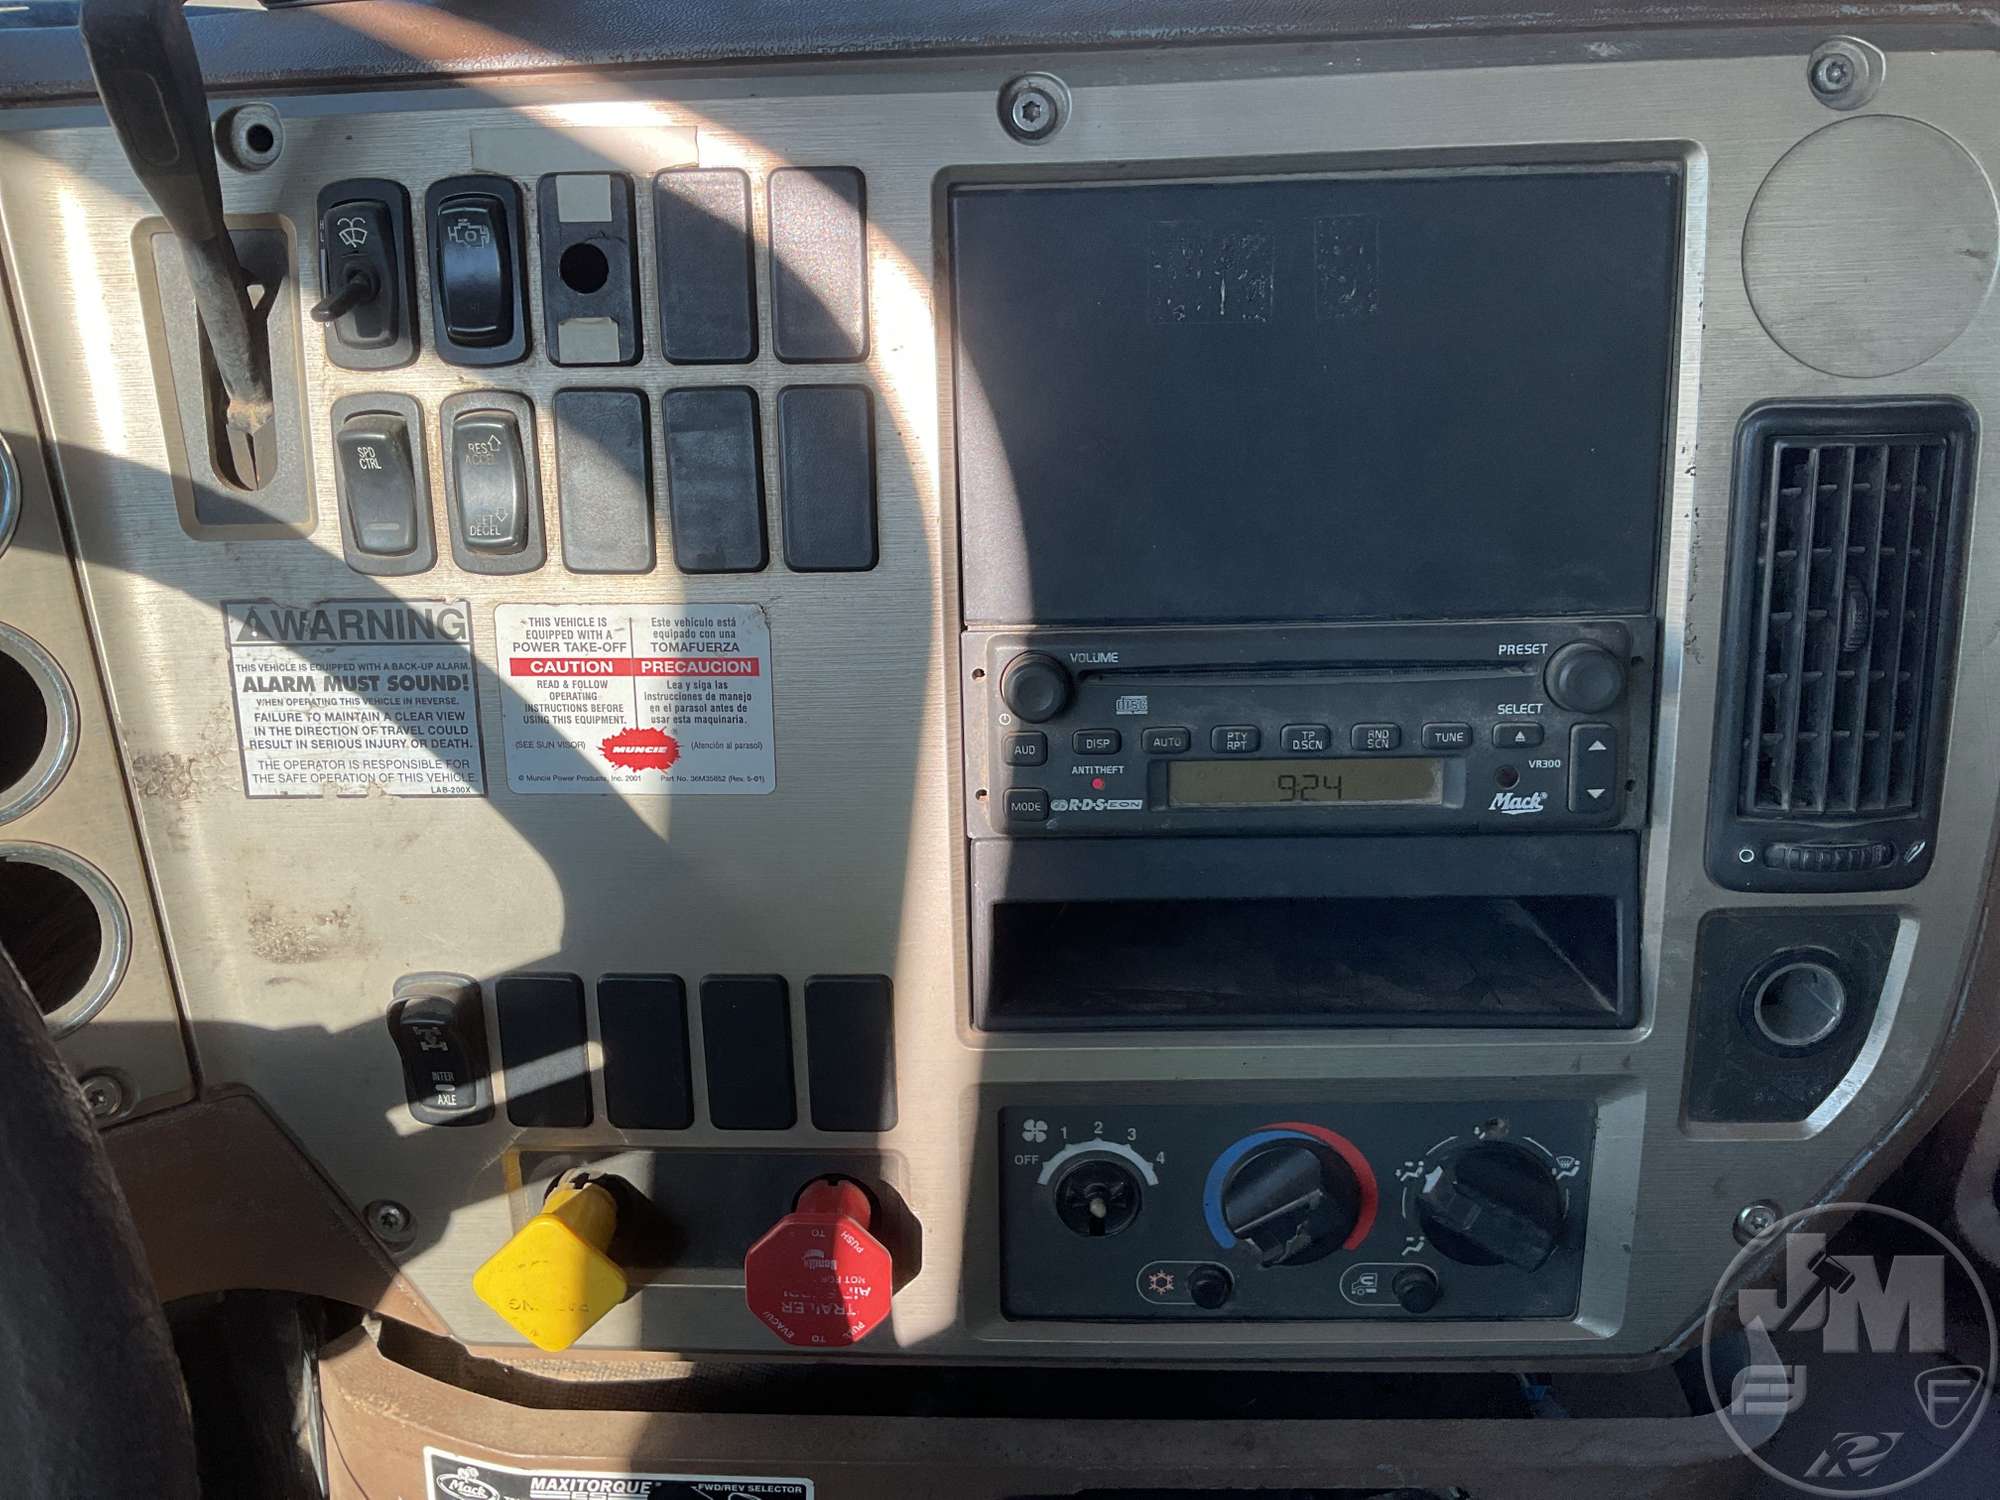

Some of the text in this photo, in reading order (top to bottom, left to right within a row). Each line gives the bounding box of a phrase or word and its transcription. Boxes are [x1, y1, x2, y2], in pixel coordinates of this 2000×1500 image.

[357, 446, 375, 459] SPD
[467, 442, 488, 455] RES
[359, 457, 382, 470] CTRL
[470, 525, 501, 536] DECEL
[270, 608, 468, 641] WARNING
[528, 616, 607, 627] THIS VEHICLE IS
[651, 617, 671, 627] Este
[717, 616, 737, 627] está
[526, 629, 613, 640] EQUIPPED WITH A
[653, 628, 736, 639] equipado con una
[512, 641, 627, 652] POWER TAKE-OFF
[650, 641, 740, 652] TOMAFUERZA
[1498, 643, 1549, 655] PRESET
[1070, 652, 1120, 663] VOLUME
[236, 662, 471, 672] THIS VEHICLE IS EQUIPPED WITH A BACK-UP ALARM.
[529, 660, 614, 673] CAUTION
[641, 660, 752, 673] PRECAUCION
[242, 674, 470, 692] ALARM MUST SOUND!
[536, 679, 608, 689] READ & FOLLOW
[666, 680, 728, 691] Lea y siga las
[255, 698, 283, 706] WHEN
[286, 698, 338, 706] OPERATING
[339, 697, 361, 706] THIS
[364, 697, 400, 705] VEHICLE
[403, 697, 412, 705] IN
[549, 691, 598, 701] OPERATING
[643, 691, 752, 702] instrucciones de manejo
[524, 703, 624, 713] INSTRUCTIONS BEFORE
[649, 704, 660, 713] en
[674, 703, 707, 714] parasol
[710, 704, 734, 713] antes
[736, 703, 748, 713] de
[1497, 703, 1544, 715] SELECT
[254, 711, 466, 722] FAILURE TO MAINTAIN A CLEAR VIEW
[523, 715, 627, 725] USING THIS EQUIPMENT.
[650, 715, 748, 725] usar esta maquinaria.
[254, 725, 469, 736] IN THE DIRECTION OF TRAVEL COULD
[1226, 731, 1248, 740] PTY
[1301, 731, 1316, 740] TP
[1367, 730, 1390, 739] RND
[1153, 737, 1181, 747] AUTO
[1435, 732, 1464, 742] TUNE
[249, 739, 473, 749] RESULT IN SERIOUS INJURY OR DEATH.
[536, 740, 555, 749] SUN
[557, 740, 586, 750] VISOR)
[612, 745, 668, 753] MUNCIE
[1085, 738, 1110, 749] DISP
[1226, 740, 1248, 750] RPT
[1367, 739, 1390, 749] SCN
[1014, 745, 1036, 755] AUD
[258, 759, 470, 770] THE OPERATOR IS RESPONSIBLE FOR
[1528, 759, 1561, 768] VR300
[252, 773, 275, 783] THE
[278, 773, 307, 783] SAFE
[310, 773, 376, 783] OPERATION
[378, 773, 395, 783] OF
[399, 773, 424, 783] THIS
[1277, 774, 1343, 801] 9:24
[1011, 801, 1041, 811] MODE
[1488, 792, 1545, 814] Mack
[431, 1071, 456, 1082] INTER
[437, 1094, 457, 1106] AXLE
[1060, 1126, 1068, 1139] 1
[1093, 1121, 1103, 1134] 2
[1127, 1128, 1137, 1140] 3
[1014, 1154, 1039, 1165] OFF
[1156, 1151, 1165, 1164] 4
[840, 1231, 865, 1254] PUSH
[448, 1479, 488, 1499] Mack
[530, 1476, 652, 1494] MAXITORQUE
[698, 1483, 802, 1494] FWD/REV SELECTOR
